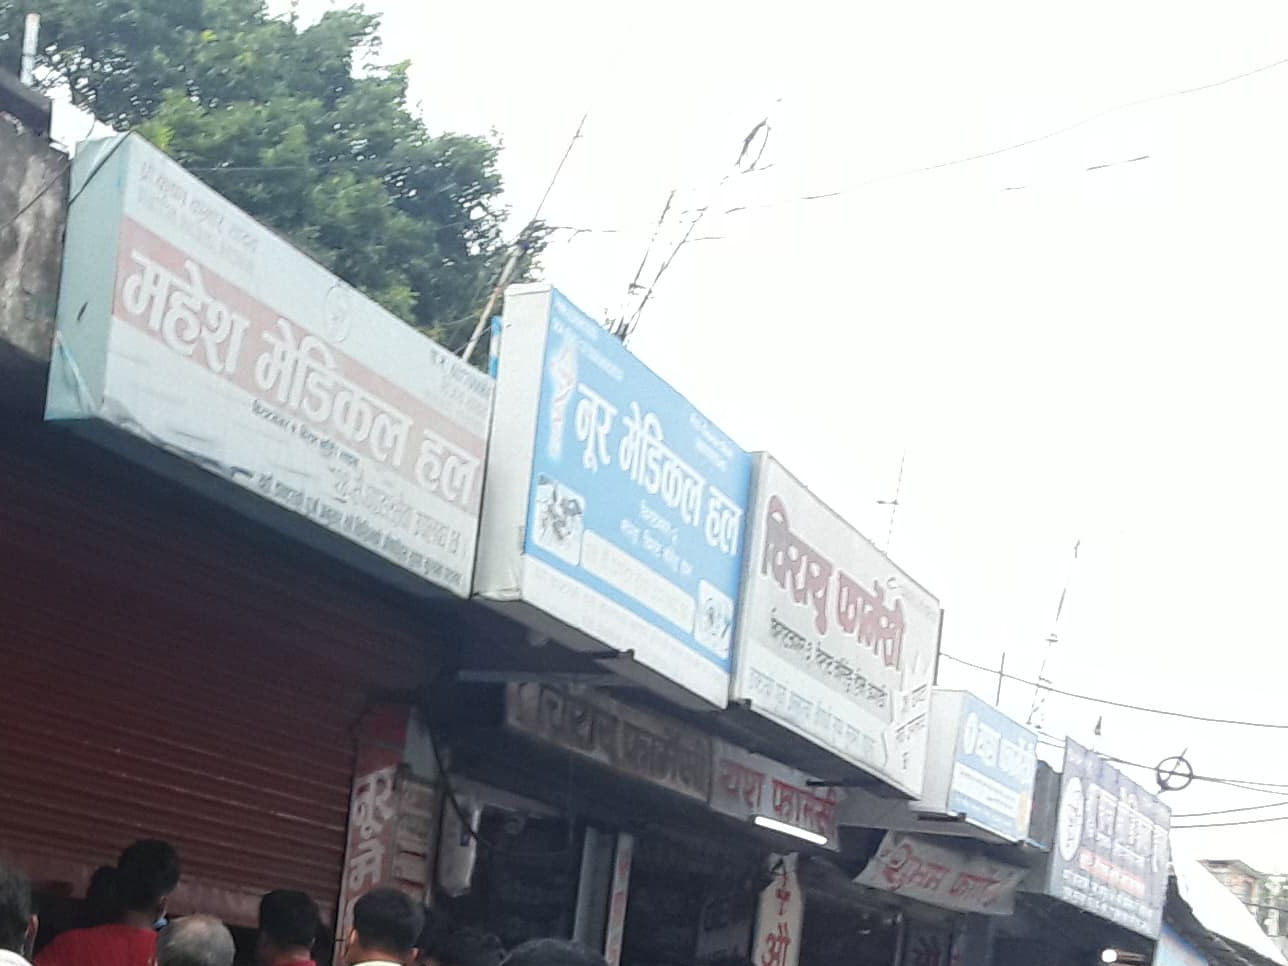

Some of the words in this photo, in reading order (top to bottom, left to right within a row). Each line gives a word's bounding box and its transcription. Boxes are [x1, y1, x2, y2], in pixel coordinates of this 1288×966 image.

[122, 250, 250, 377] महेश
[255, 316, 414, 467] मेडिकल
[415, 429, 481, 506] हल
[573, 380, 618, 475] नूर
[618, 400, 707, 529] मेडिकल
[704, 484, 743, 556] हल
